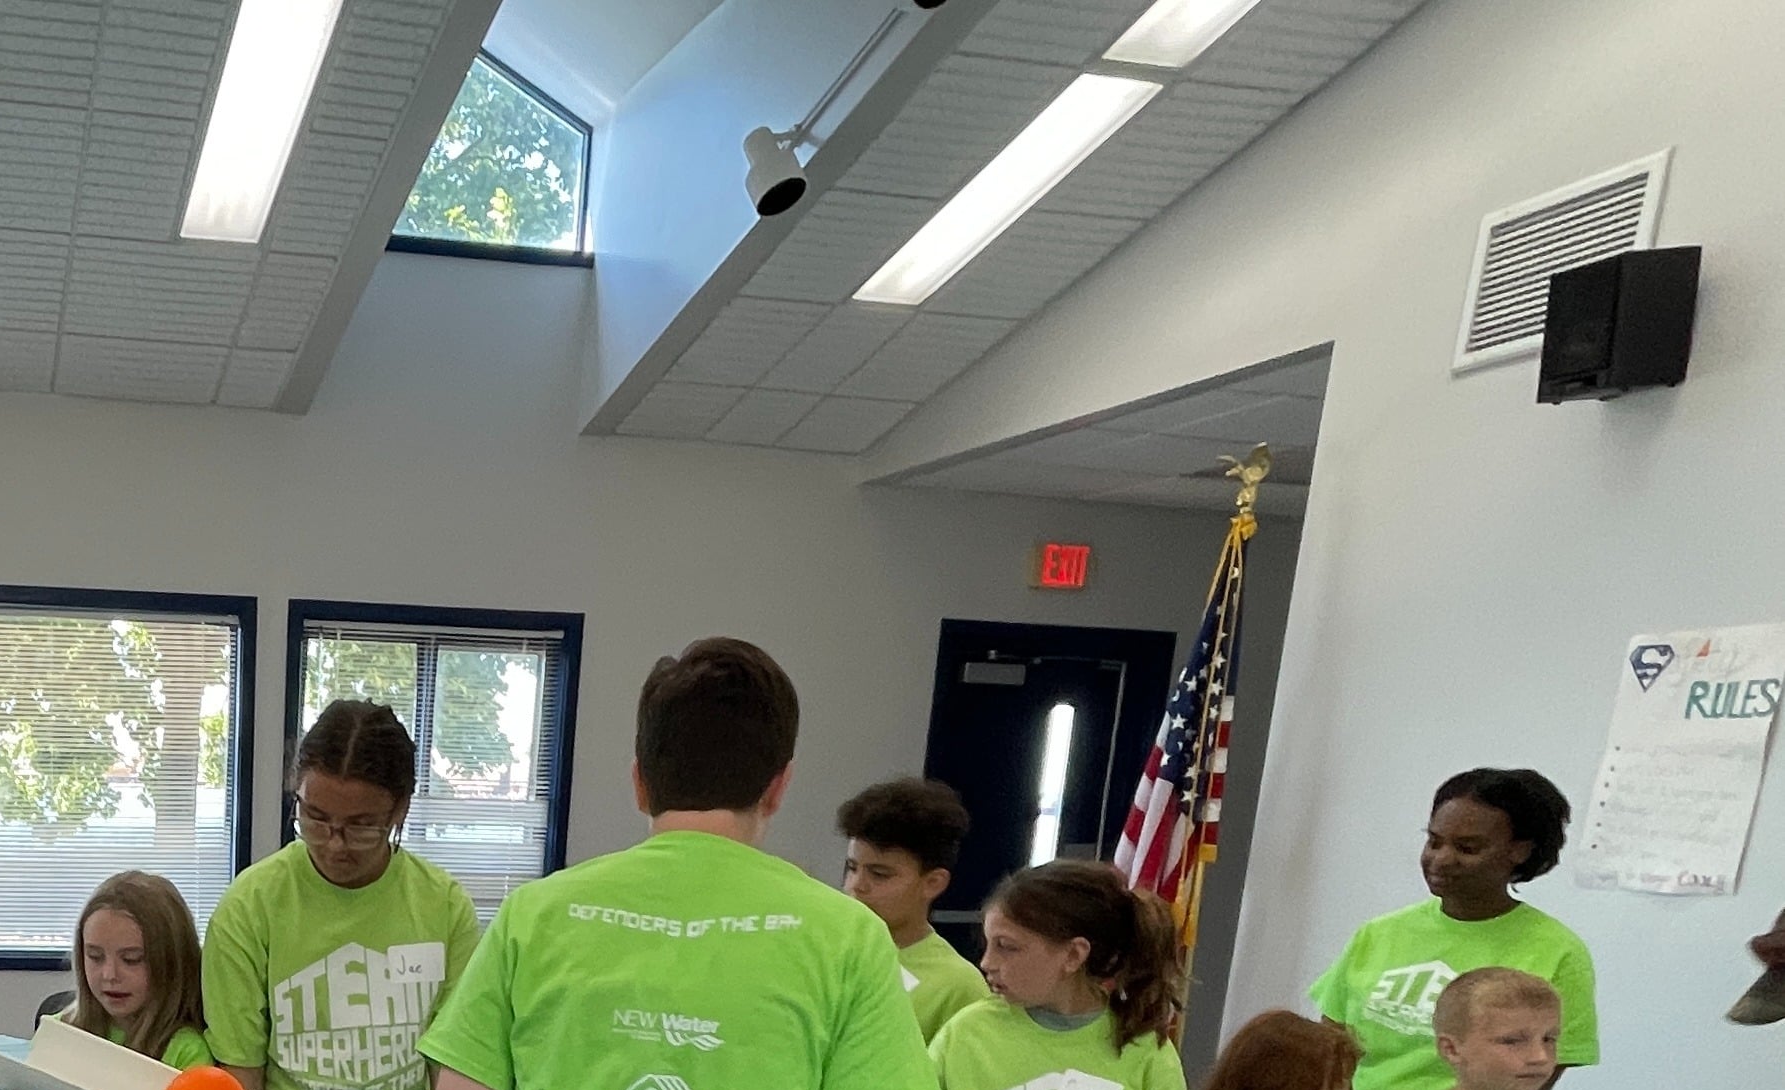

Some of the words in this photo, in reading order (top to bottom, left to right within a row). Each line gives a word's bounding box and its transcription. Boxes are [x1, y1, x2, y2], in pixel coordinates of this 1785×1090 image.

[1042, 543, 1091, 588] EXIT
[1684, 678, 1781, 720] RULES
[568, 903, 683, 937] DEFENDERS
[686, 919, 716, 938] OF
[720, 916, 761, 932] THE
[764, 914, 803, 931] BAY
[613, 1008, 659, 1028] NEW
[662, 1012, 720, 1033] Water
